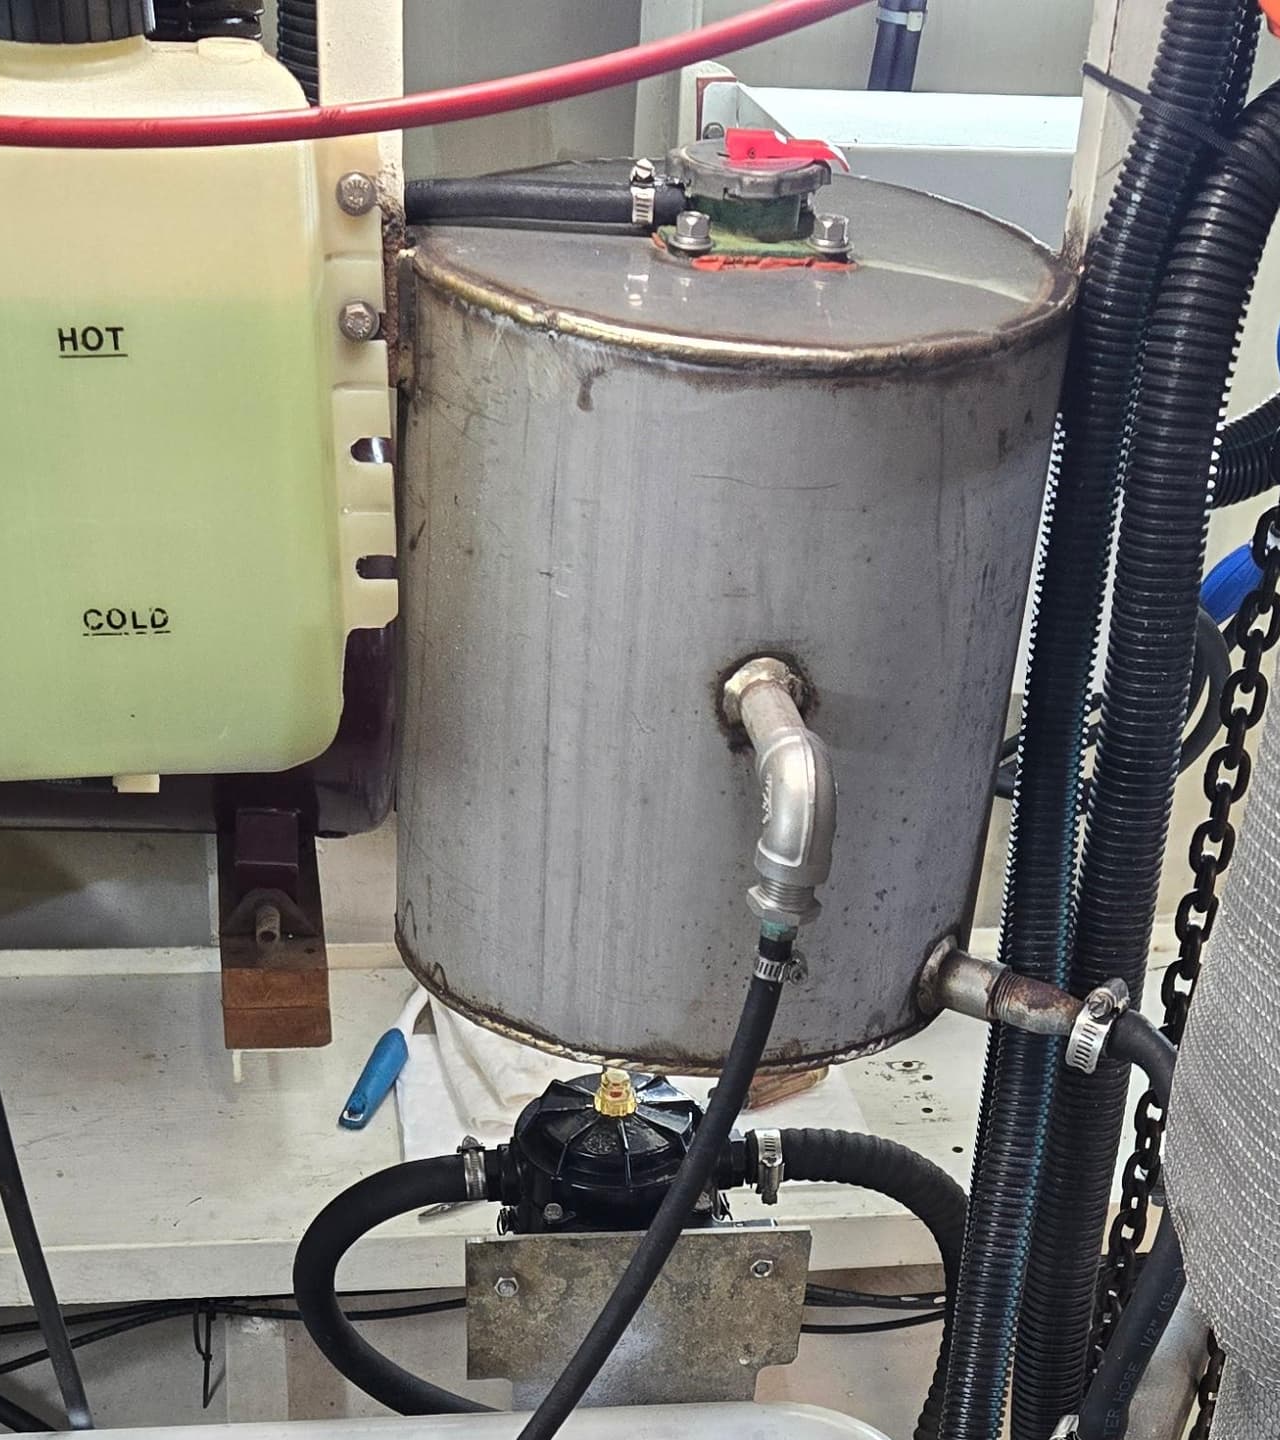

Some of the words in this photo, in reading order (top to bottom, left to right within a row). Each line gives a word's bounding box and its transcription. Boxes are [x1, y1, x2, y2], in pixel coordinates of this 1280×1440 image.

[57, 326, 124, 352] HOT
[83, 608, 169, 631] COLD
[1113, 1360, 1140, 1403] HOSE
